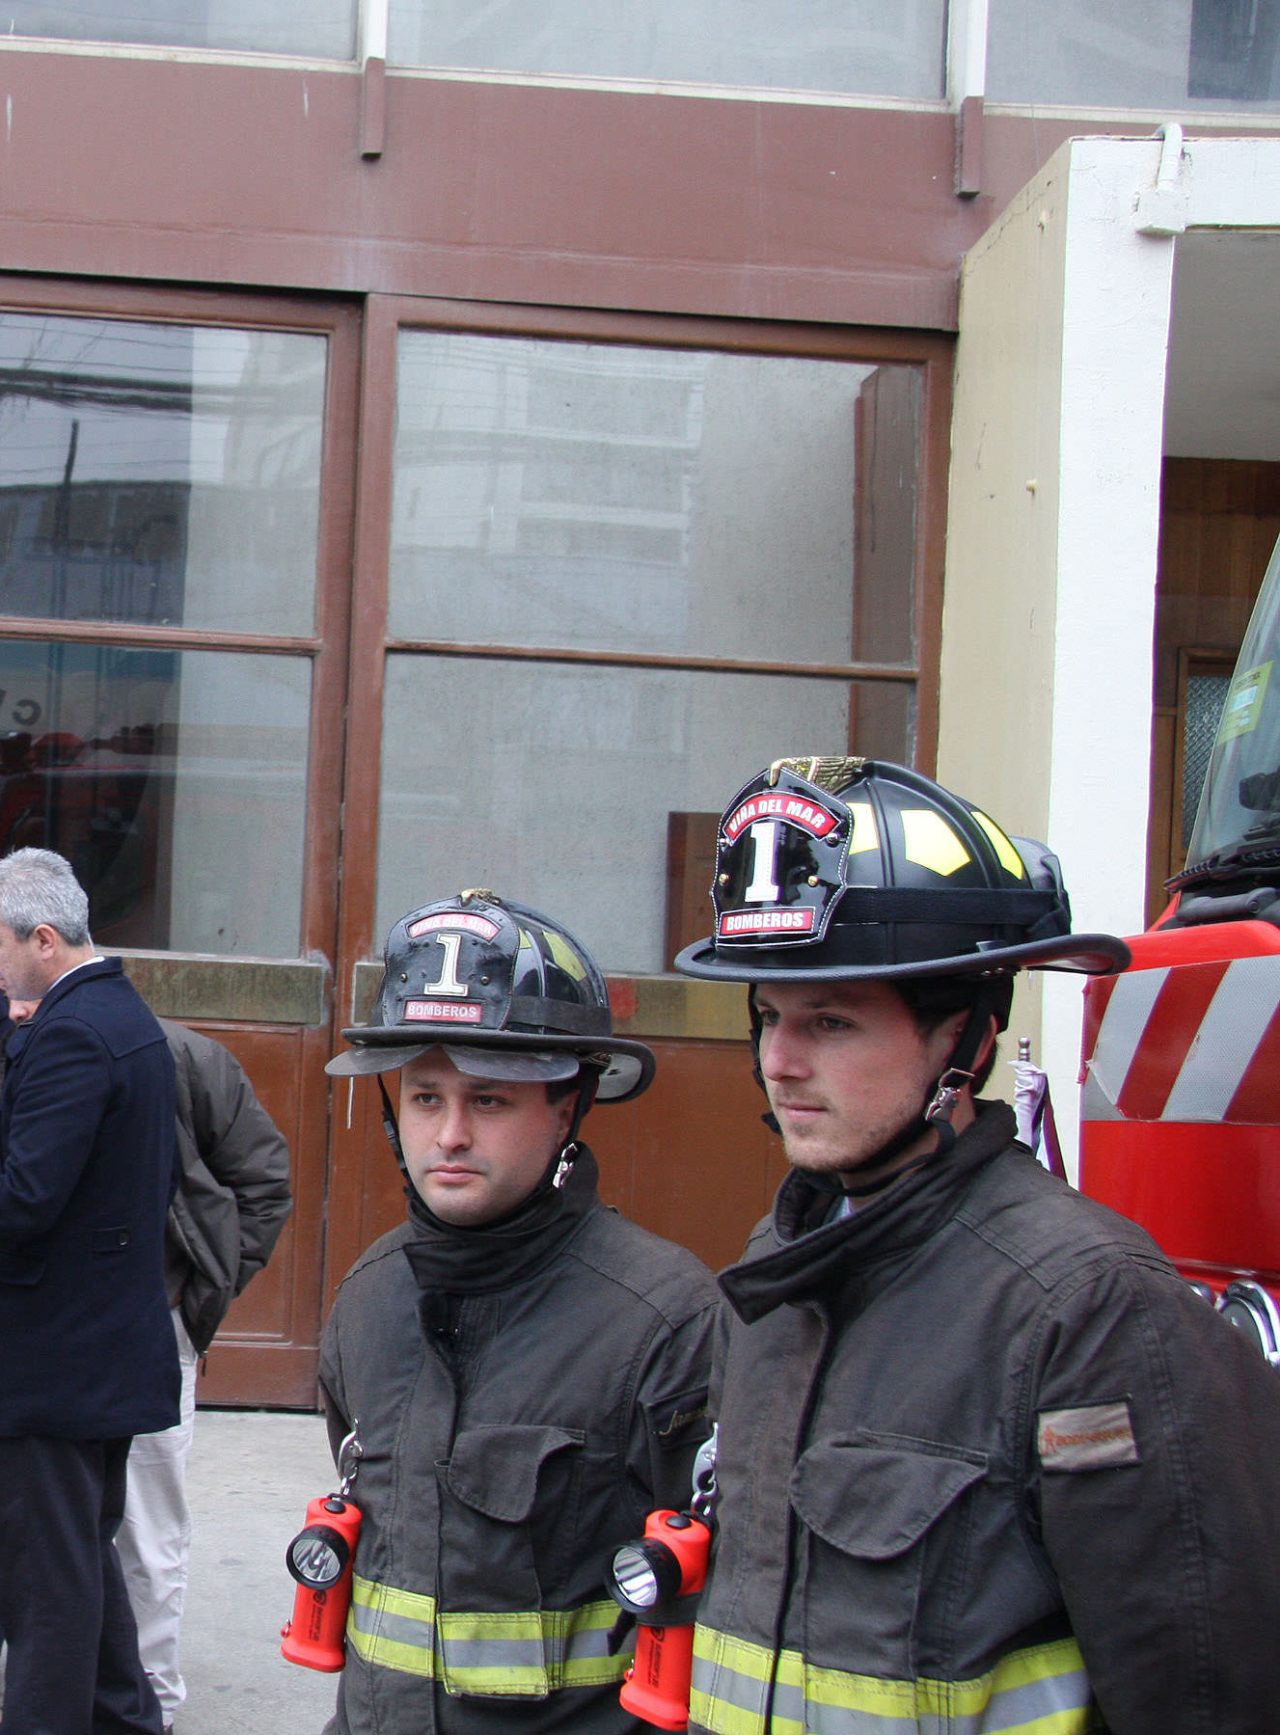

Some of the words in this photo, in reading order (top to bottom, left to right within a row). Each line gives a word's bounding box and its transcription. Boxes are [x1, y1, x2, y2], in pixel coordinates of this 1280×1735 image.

[758, 799, 783, 813] DEL
[786, 801, 826, 829] MAR
[745, 822, 780, 902] 1
[726, 912, 804, 931] BOMBEROS
[424, 933, 468, 997] 1
[408, 1005, 478, 1018] BOMBEROS
